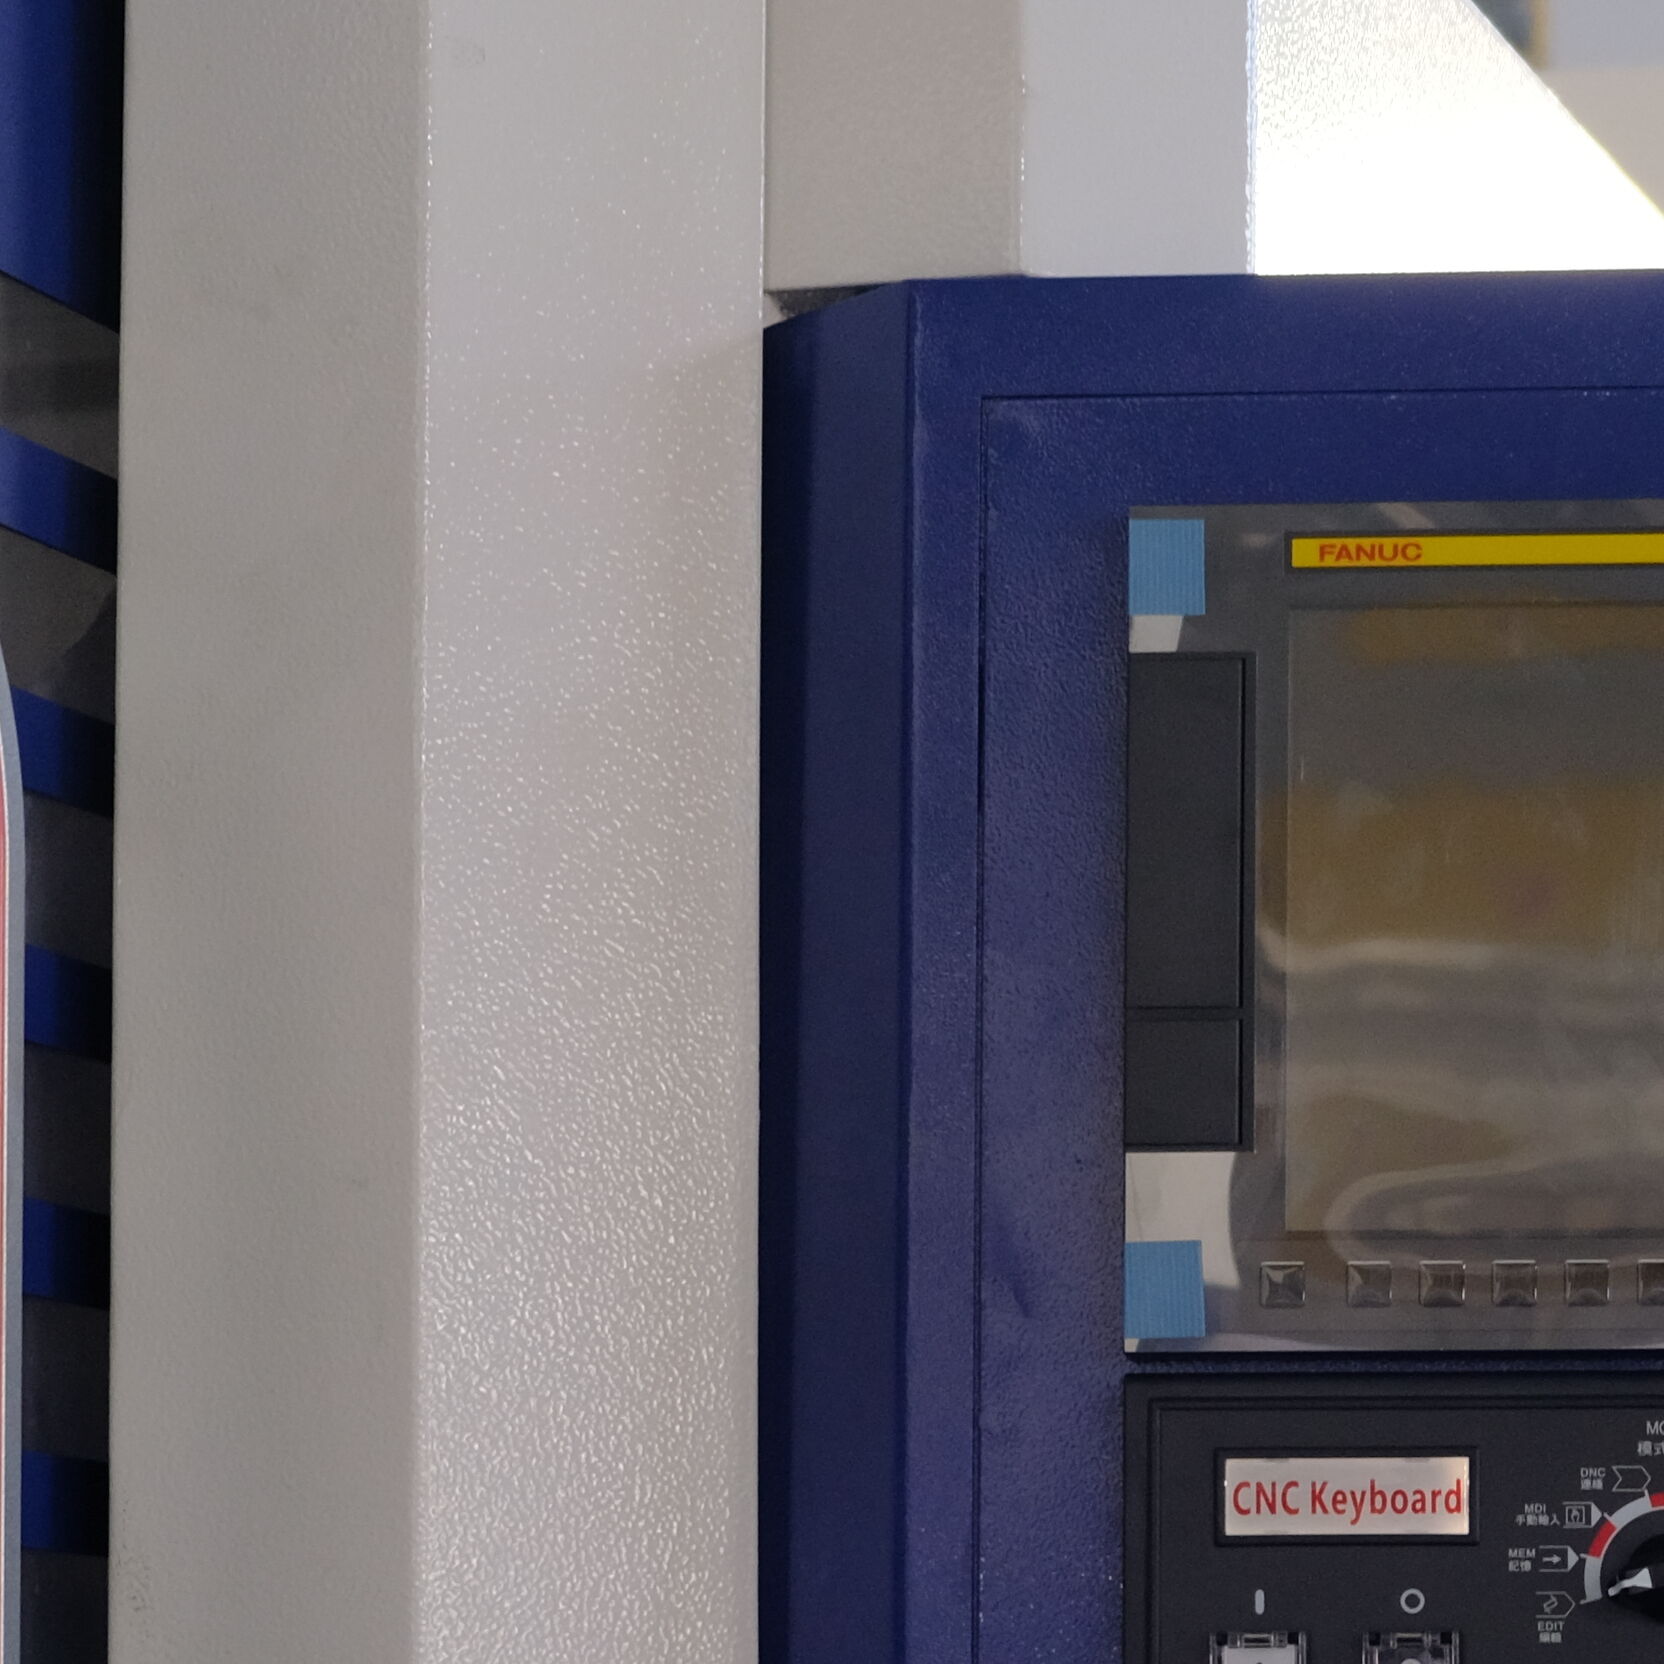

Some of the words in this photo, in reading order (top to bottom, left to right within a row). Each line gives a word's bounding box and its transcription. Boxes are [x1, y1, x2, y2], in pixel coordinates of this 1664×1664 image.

[1318, 541, 1424, 563] FANUC
[1580, 1467, 1606, 1479] DNC
[1232, 1480, 1300, 1516] CNC
[1310, 1479, 1462, 1526] Keyboard
[1524, 1503, 1547, 1515] MDI
[1508, 1548, 1535, 1560] MEM
[1537, 1621, 1565, 1633] EDIT
